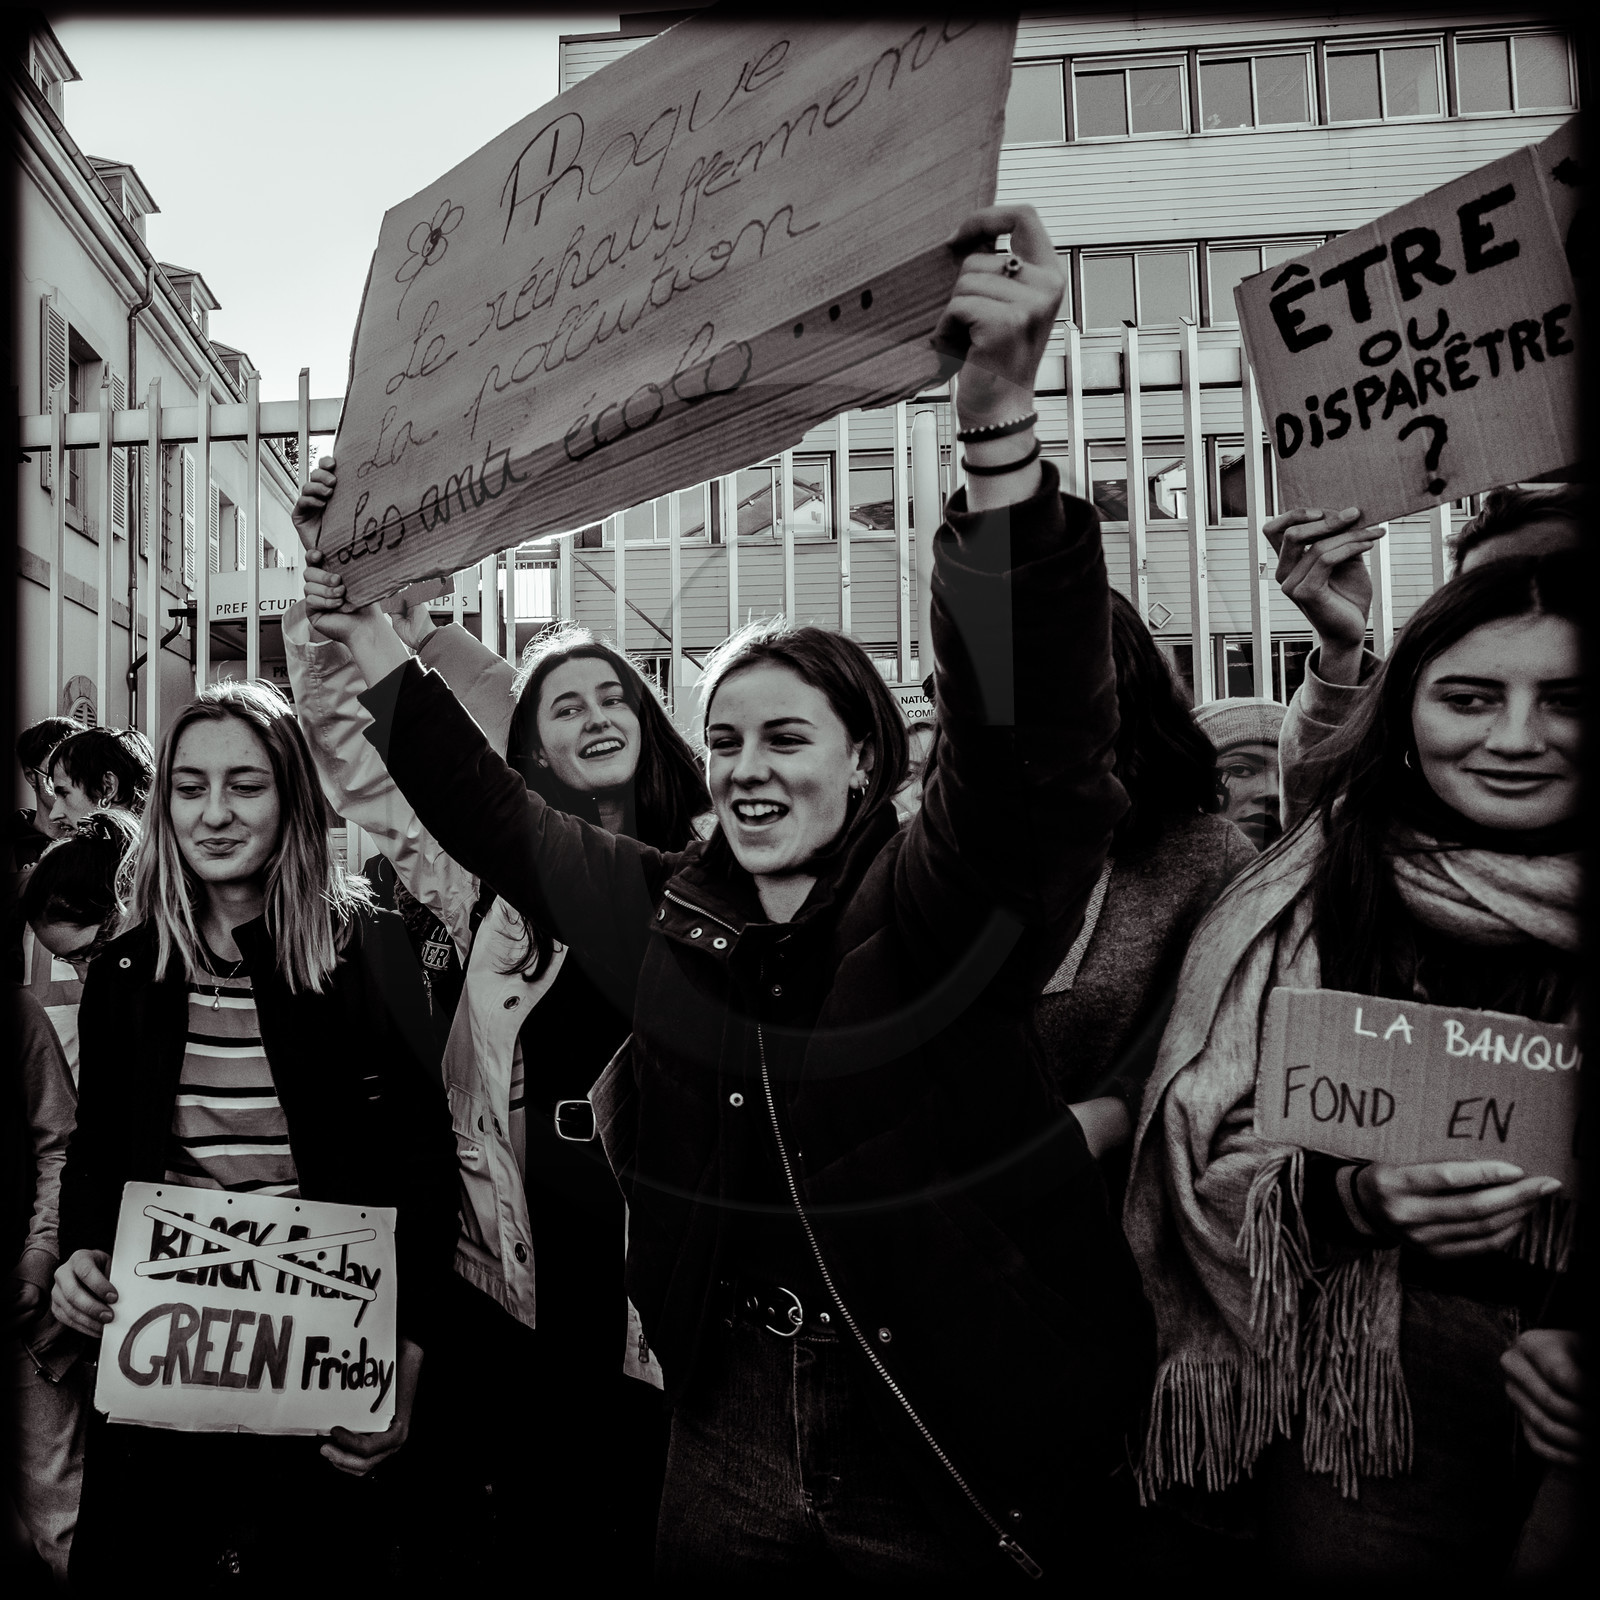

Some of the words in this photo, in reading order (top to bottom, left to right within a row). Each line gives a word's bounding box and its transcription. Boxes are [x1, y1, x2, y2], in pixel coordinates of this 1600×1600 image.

[1269, 183, 1521, 354] ÊTRE
[463, 204, 821, 441] pollution
[1359, 308, 1450, 368] OU
[420, 440, 530, 533] anti
[1398, 413, 1449, 497] ?
[216, 598, 297, 615] PREFCTU
[428, 596, 468, 607] LPS
[1354, 1007, 1415, 1045] LA
[1443, 1019, 1584, 1072] BANQU
[1283, 1064, 1396, 1128] FOND
[1446, 1097, 1515, 1143] EN
[147, 1209, 277, 1293] BLACK
[276, 1225, 382, 1328] Friday
[118, 1302, 294, 1393] GREEN
[301, 1336, 394, 1413] Friday
